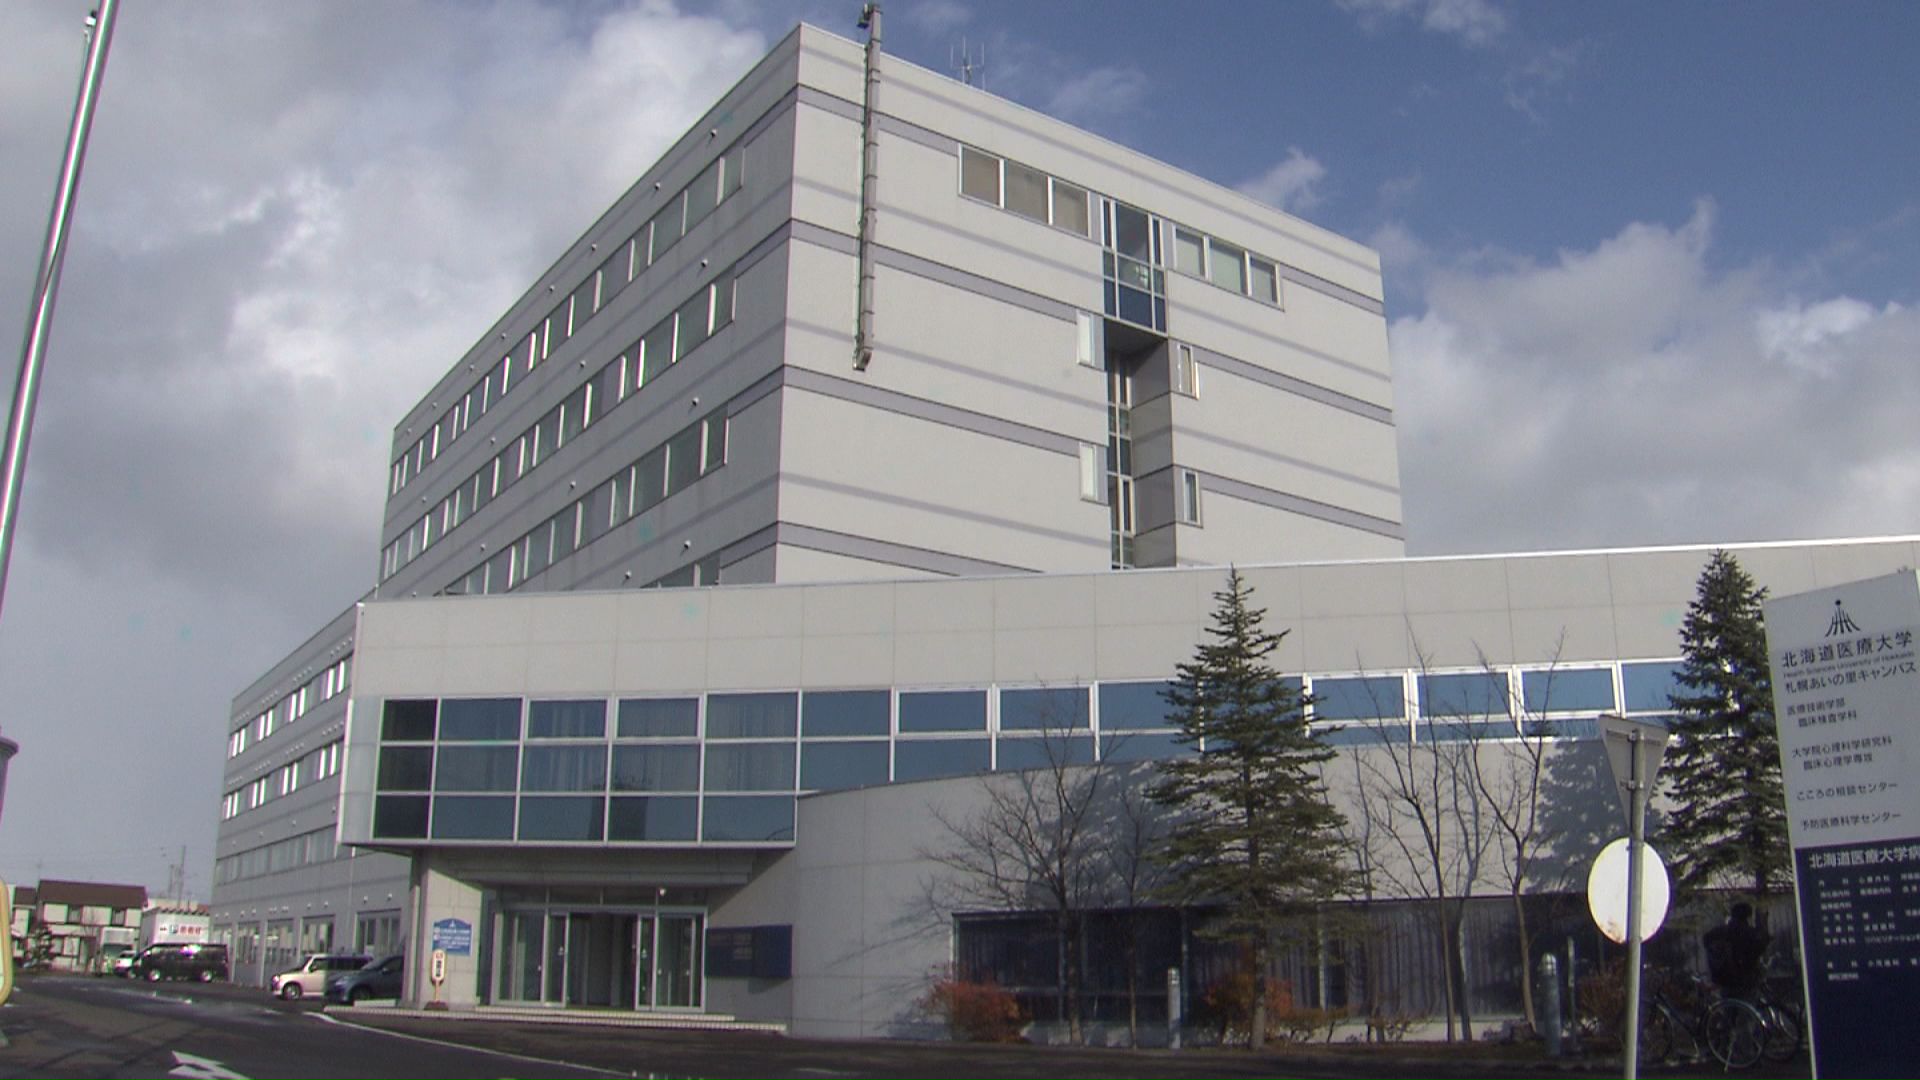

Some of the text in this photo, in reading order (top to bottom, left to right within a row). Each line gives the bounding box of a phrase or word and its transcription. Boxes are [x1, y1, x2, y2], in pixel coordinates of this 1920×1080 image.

[1782, 631, 1912, 668] 北海道医療大学
[1785, 662, 1916, 693] 札幌あいの里キャンパス
[1797, 781, 1898, 801] こころの相談センター
[1803, 811, 1901, 831] 予防医療科学センター
